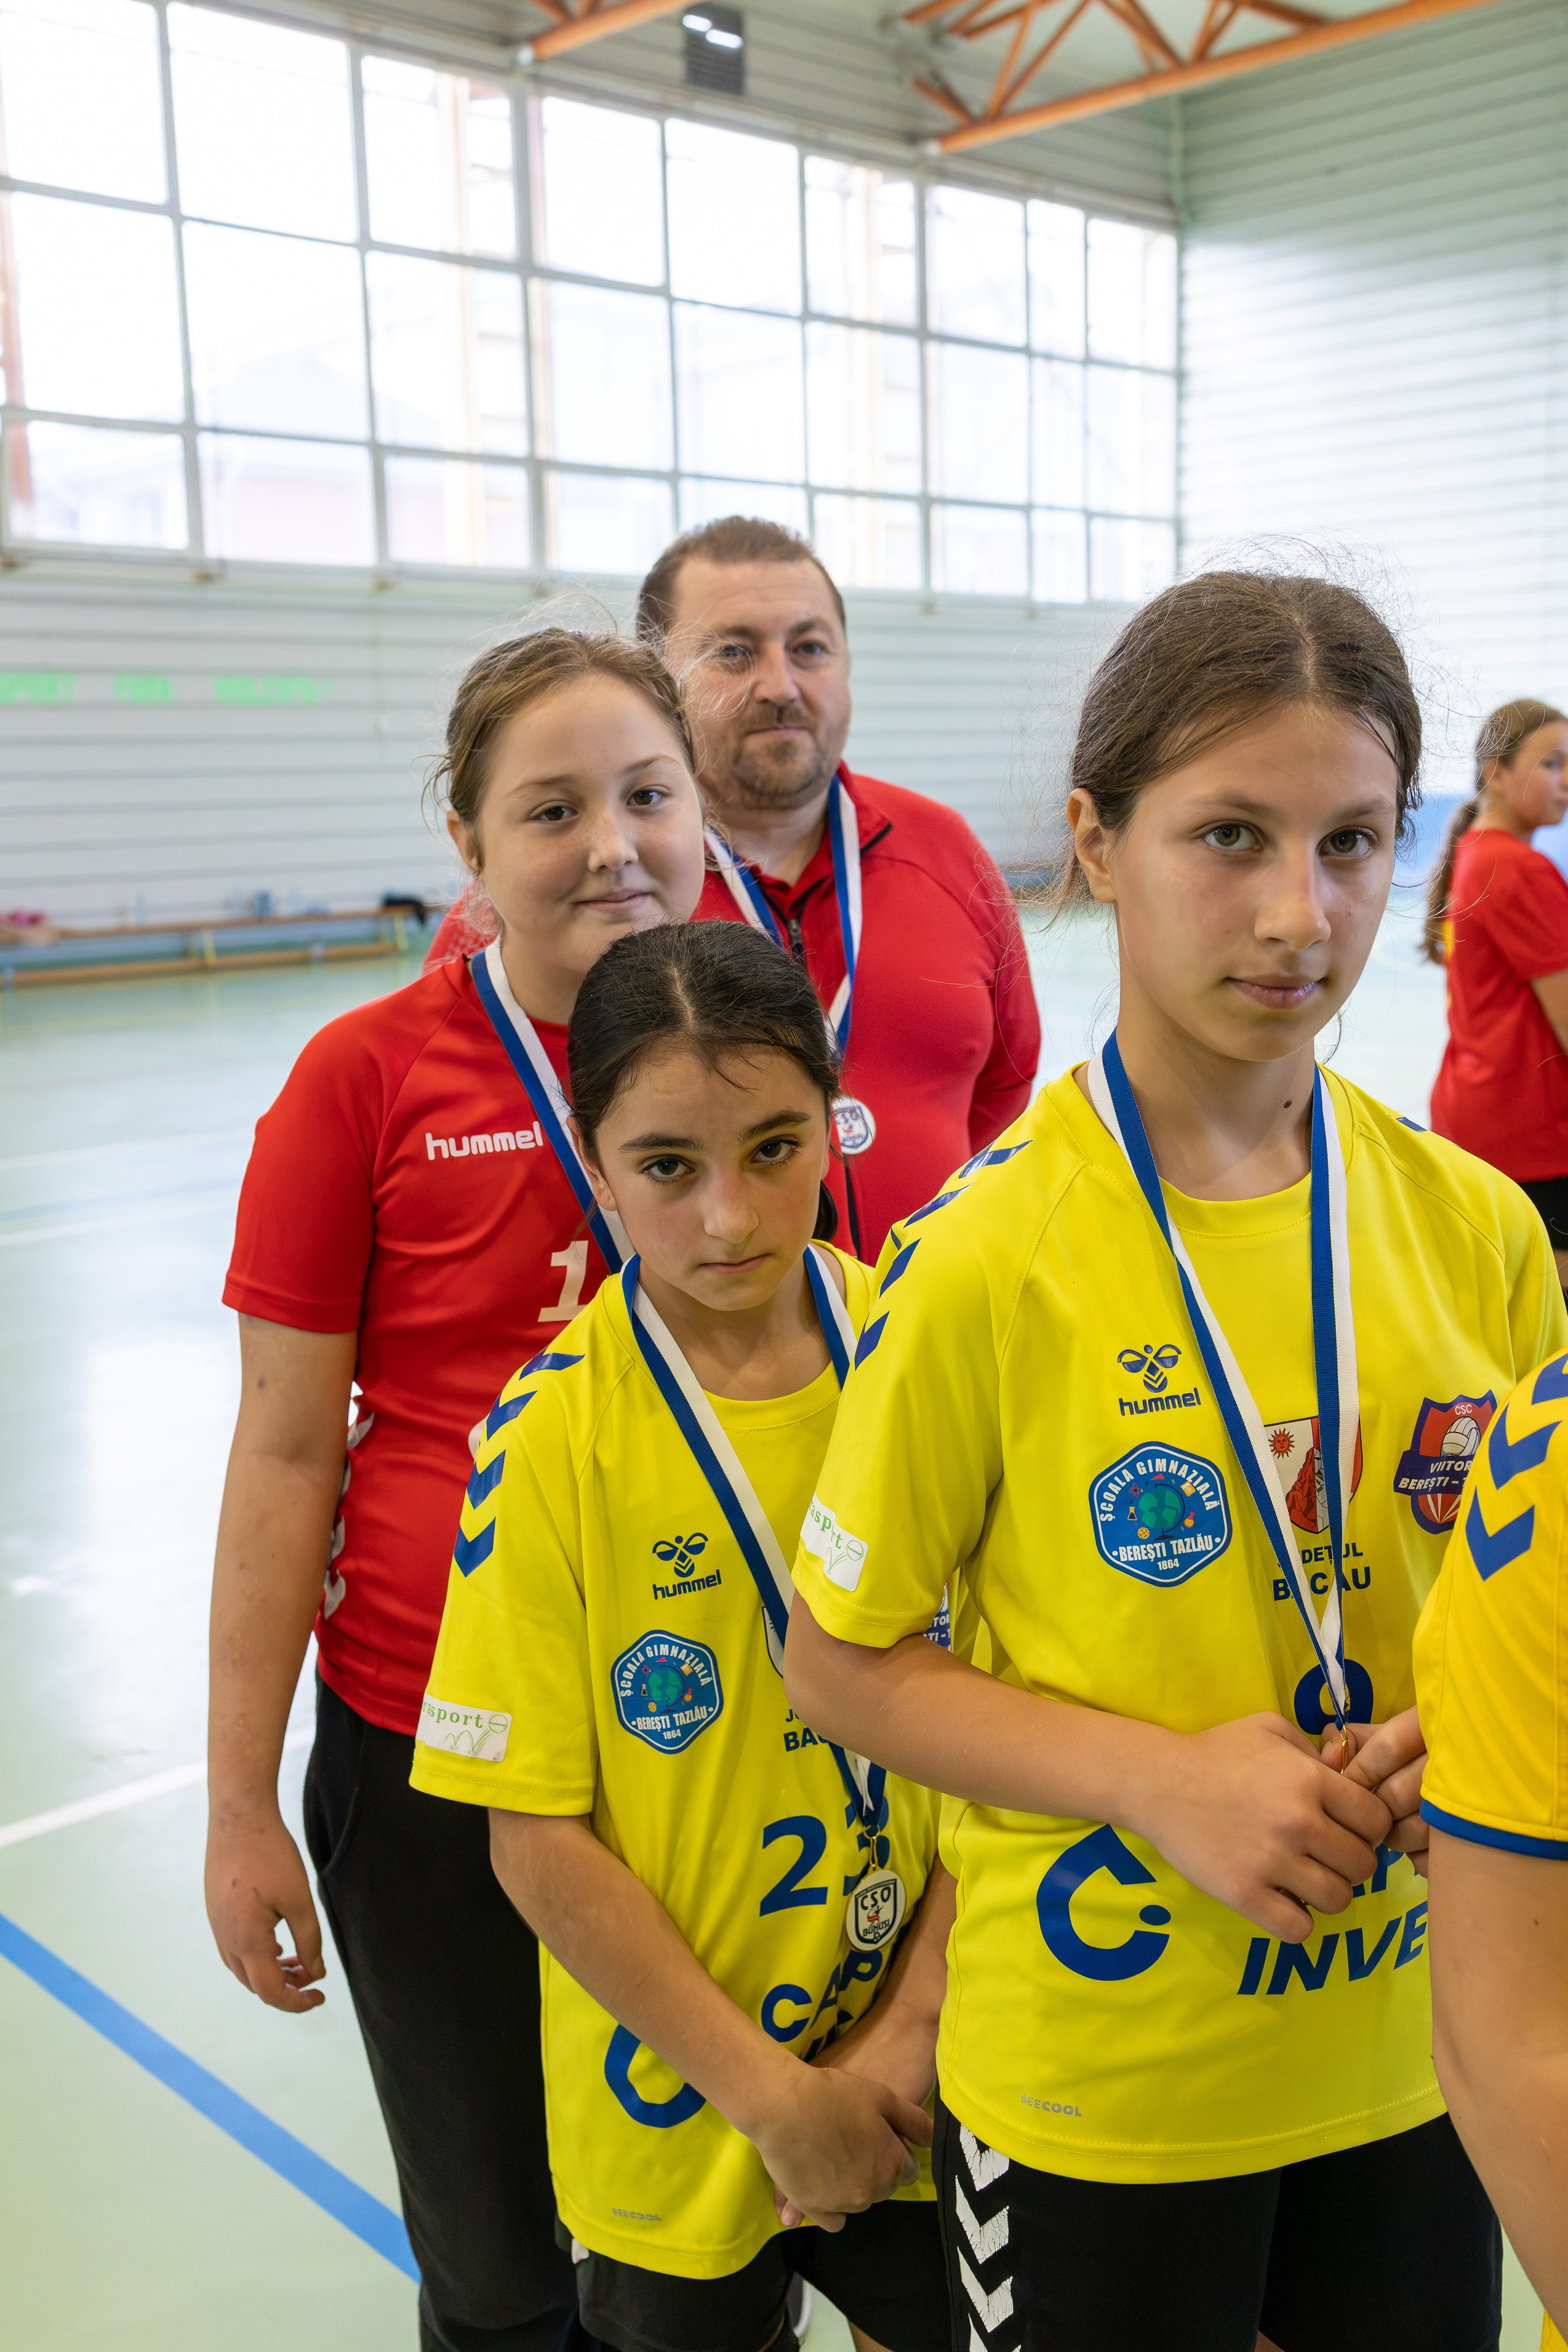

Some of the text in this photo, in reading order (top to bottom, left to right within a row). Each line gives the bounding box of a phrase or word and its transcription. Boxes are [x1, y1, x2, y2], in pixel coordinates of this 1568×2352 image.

[425, 1121, 544, 1161] hummel
[1118, 1387, 1201, 1416] hummel
[1455, 1404, 1472, 1415] CSC
[1136, 1458, 1221, 1511] GIMNAZIALĂ
[1170, 1533, 1213, 1555] TAZLĂU
[1157, 1558, 1180, 1570] 1864
[652, 1569, 722, 1600] hummel
[646, 1644, 714, 1686] GIMNAZIALĂ
[673, 1705, 707, 1727] TAZLĂU
[663, 1729, 682, 1740] 1864
[759, 1795, 891, 1917] 23
[861, 1887, 891, 1910] CSO
[1021, 2093, 1082, 2117] BEECOOL
